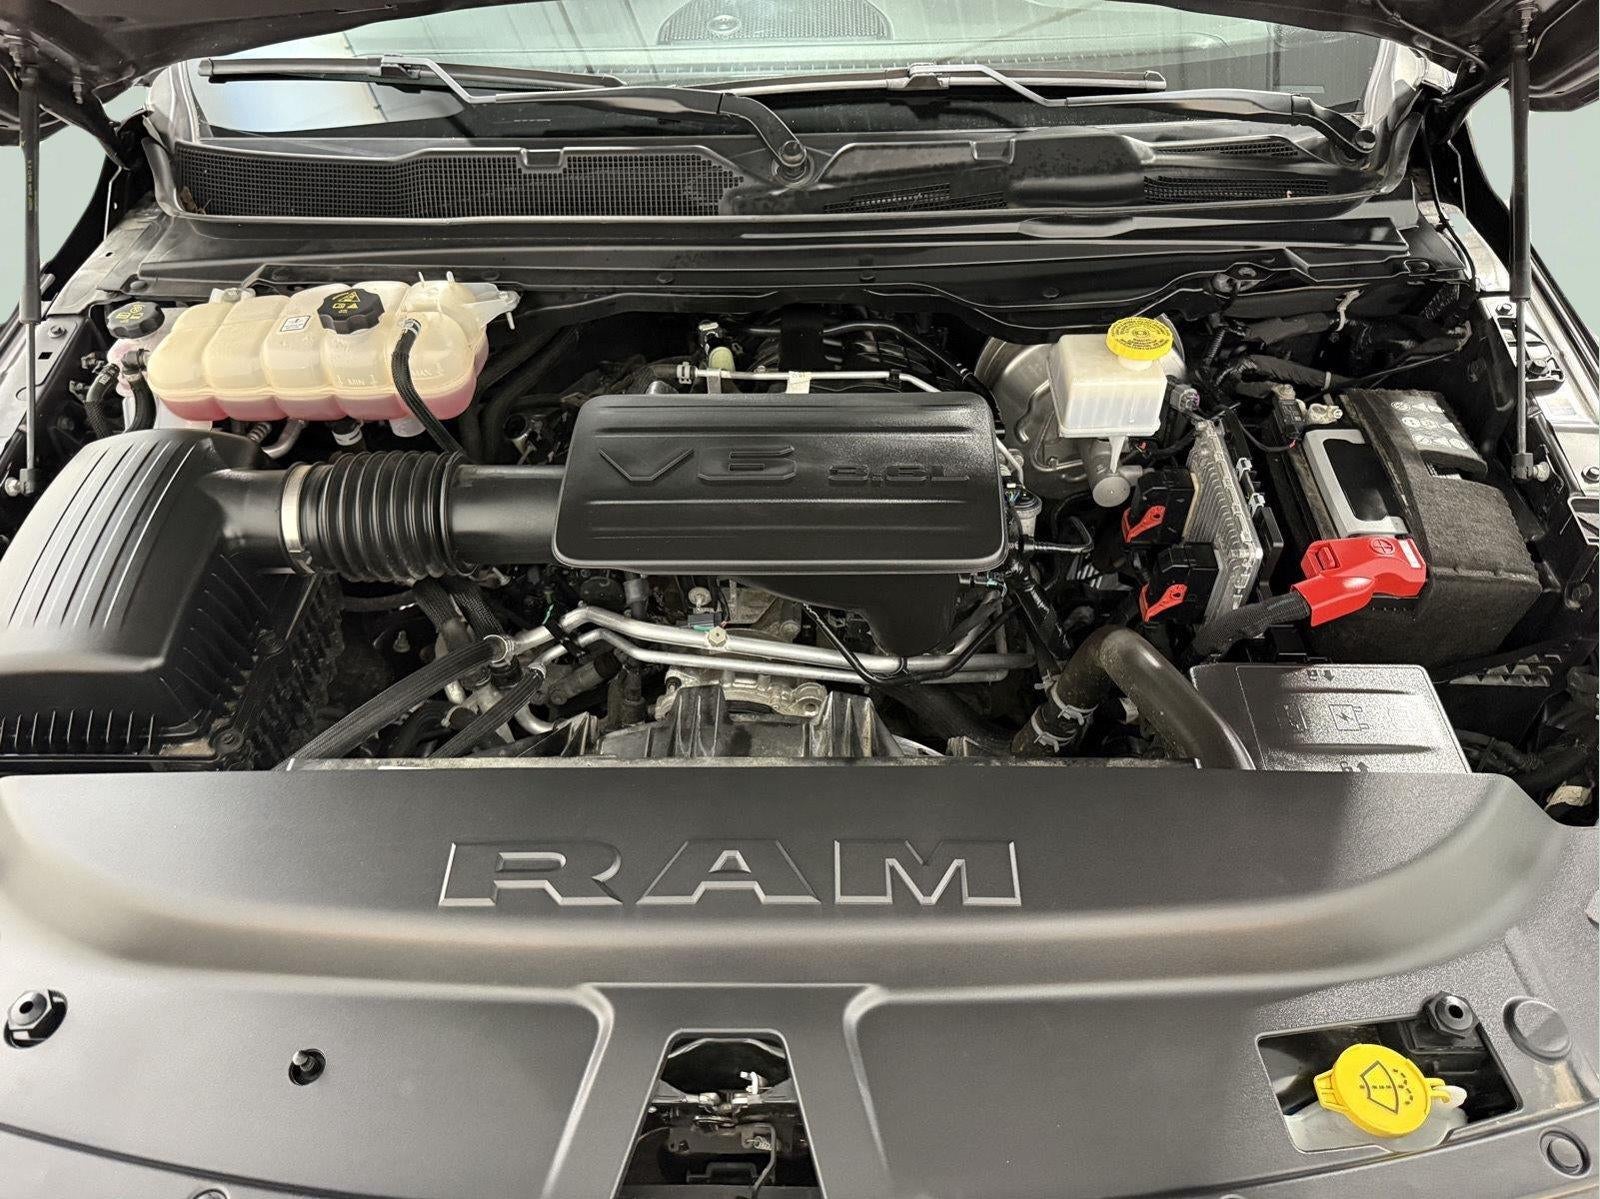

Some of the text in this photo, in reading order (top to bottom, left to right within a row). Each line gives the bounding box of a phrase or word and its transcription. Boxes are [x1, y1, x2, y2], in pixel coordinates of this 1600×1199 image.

[598, 446, 971, 483] V6 3.6L
[437, 839, 1023, 907] RAM
